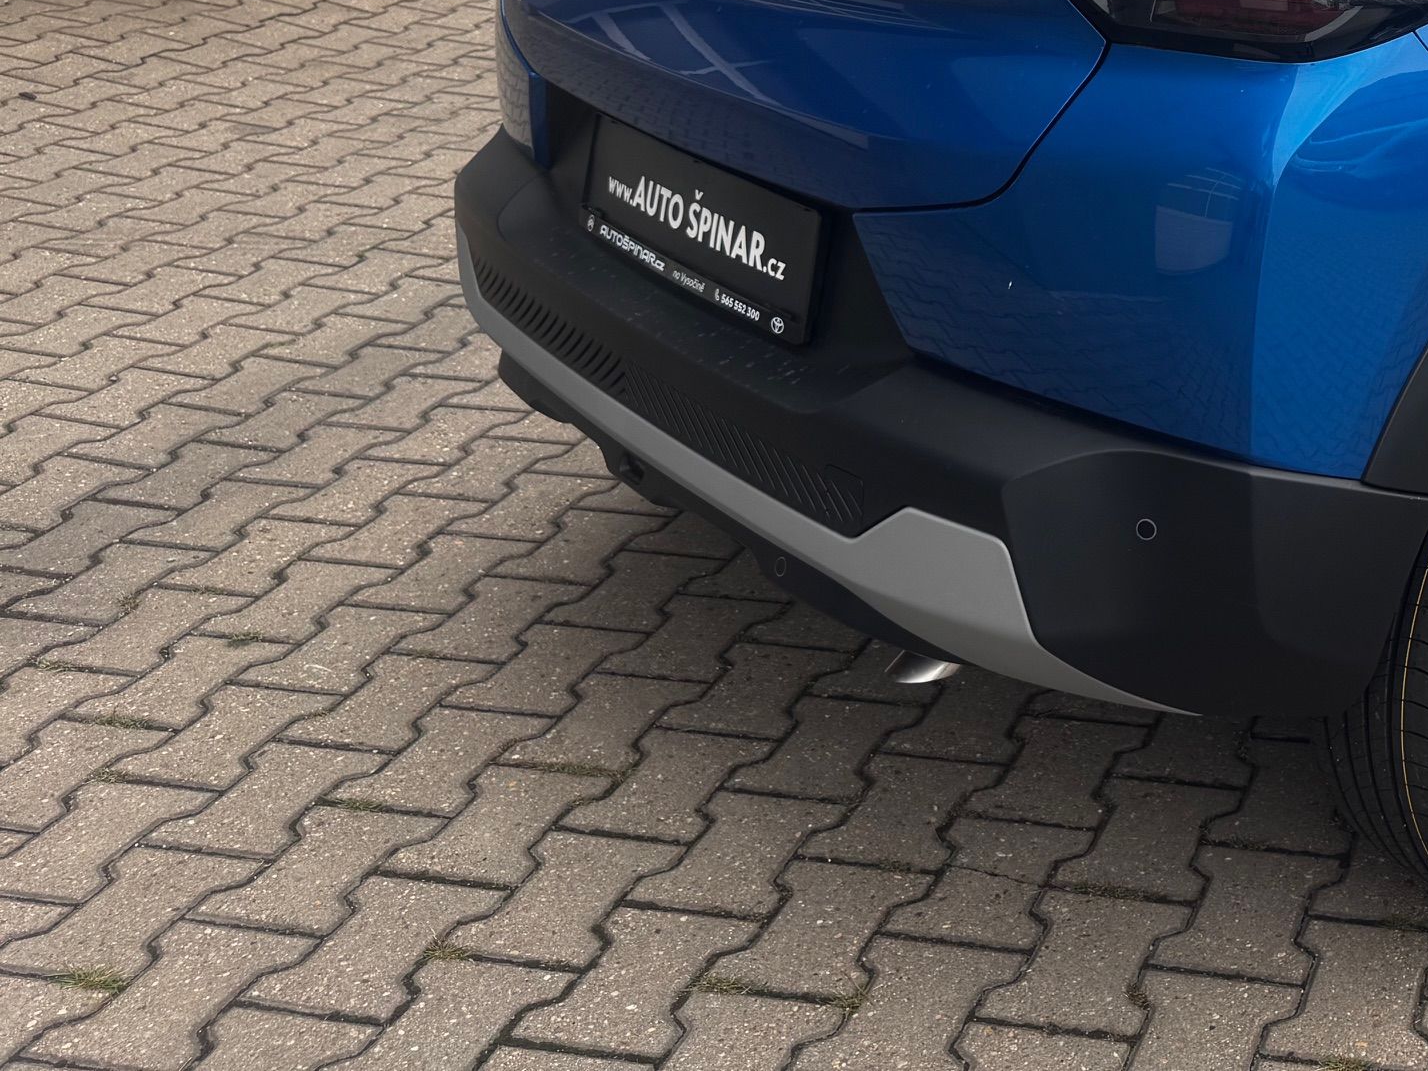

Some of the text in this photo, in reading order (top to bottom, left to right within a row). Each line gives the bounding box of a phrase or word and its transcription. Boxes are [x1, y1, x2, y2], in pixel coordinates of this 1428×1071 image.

[609, 176, 785, 280] www.AUTO ŠPINAR.cz
[721, 293, 734, 307] 565
[734, 300, 747, 315] 552
[746, 307, 760, 321] 300
